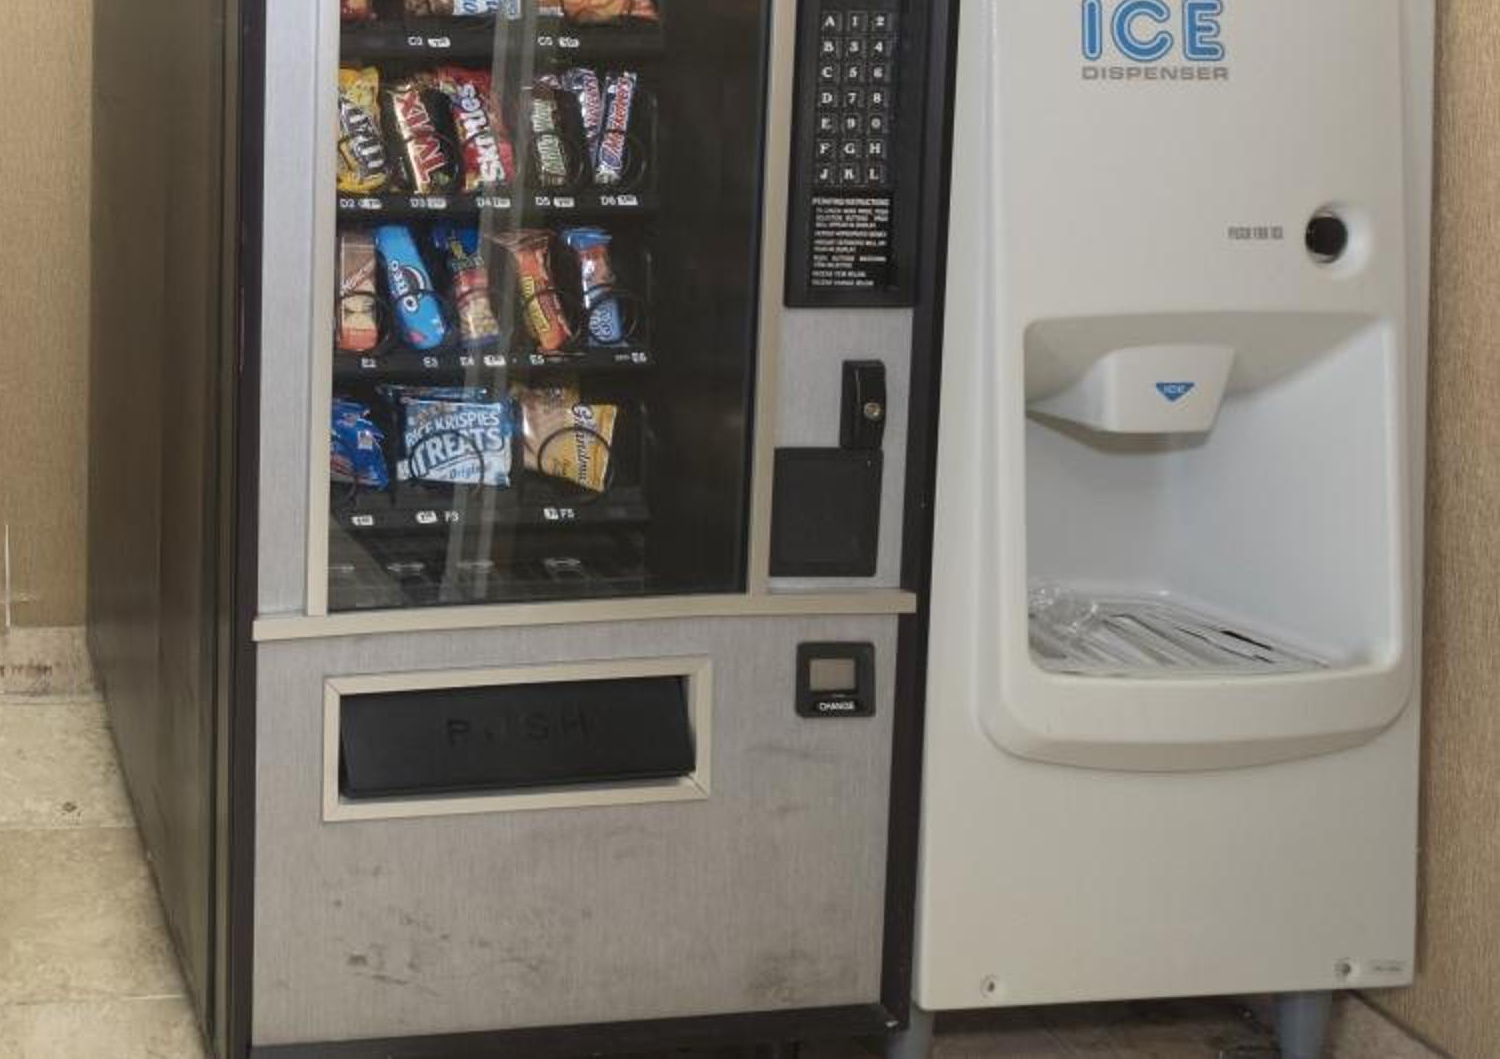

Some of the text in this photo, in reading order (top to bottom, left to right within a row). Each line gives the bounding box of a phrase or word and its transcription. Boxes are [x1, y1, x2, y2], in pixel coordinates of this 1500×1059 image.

[824, 15, 835, 27] A
[851, 15, 858, 27] 1
[823, 41, 834, 52] B
[874, 41, 883, 52] 4
[821, 67, 832, 78] C
[849, 67, 857, 78] 5
[1081, 65, 1229, 81] DISPENSER
[821, 93, 881, 103] D 7 8
[821, 118, 831, 129] E
[820, 143, 881, 154] F G H
[819, 168, 879, 180] J K L
[434, 413, 500, 431] KRISPIES
[411, 427, 501, 478] TREATS
